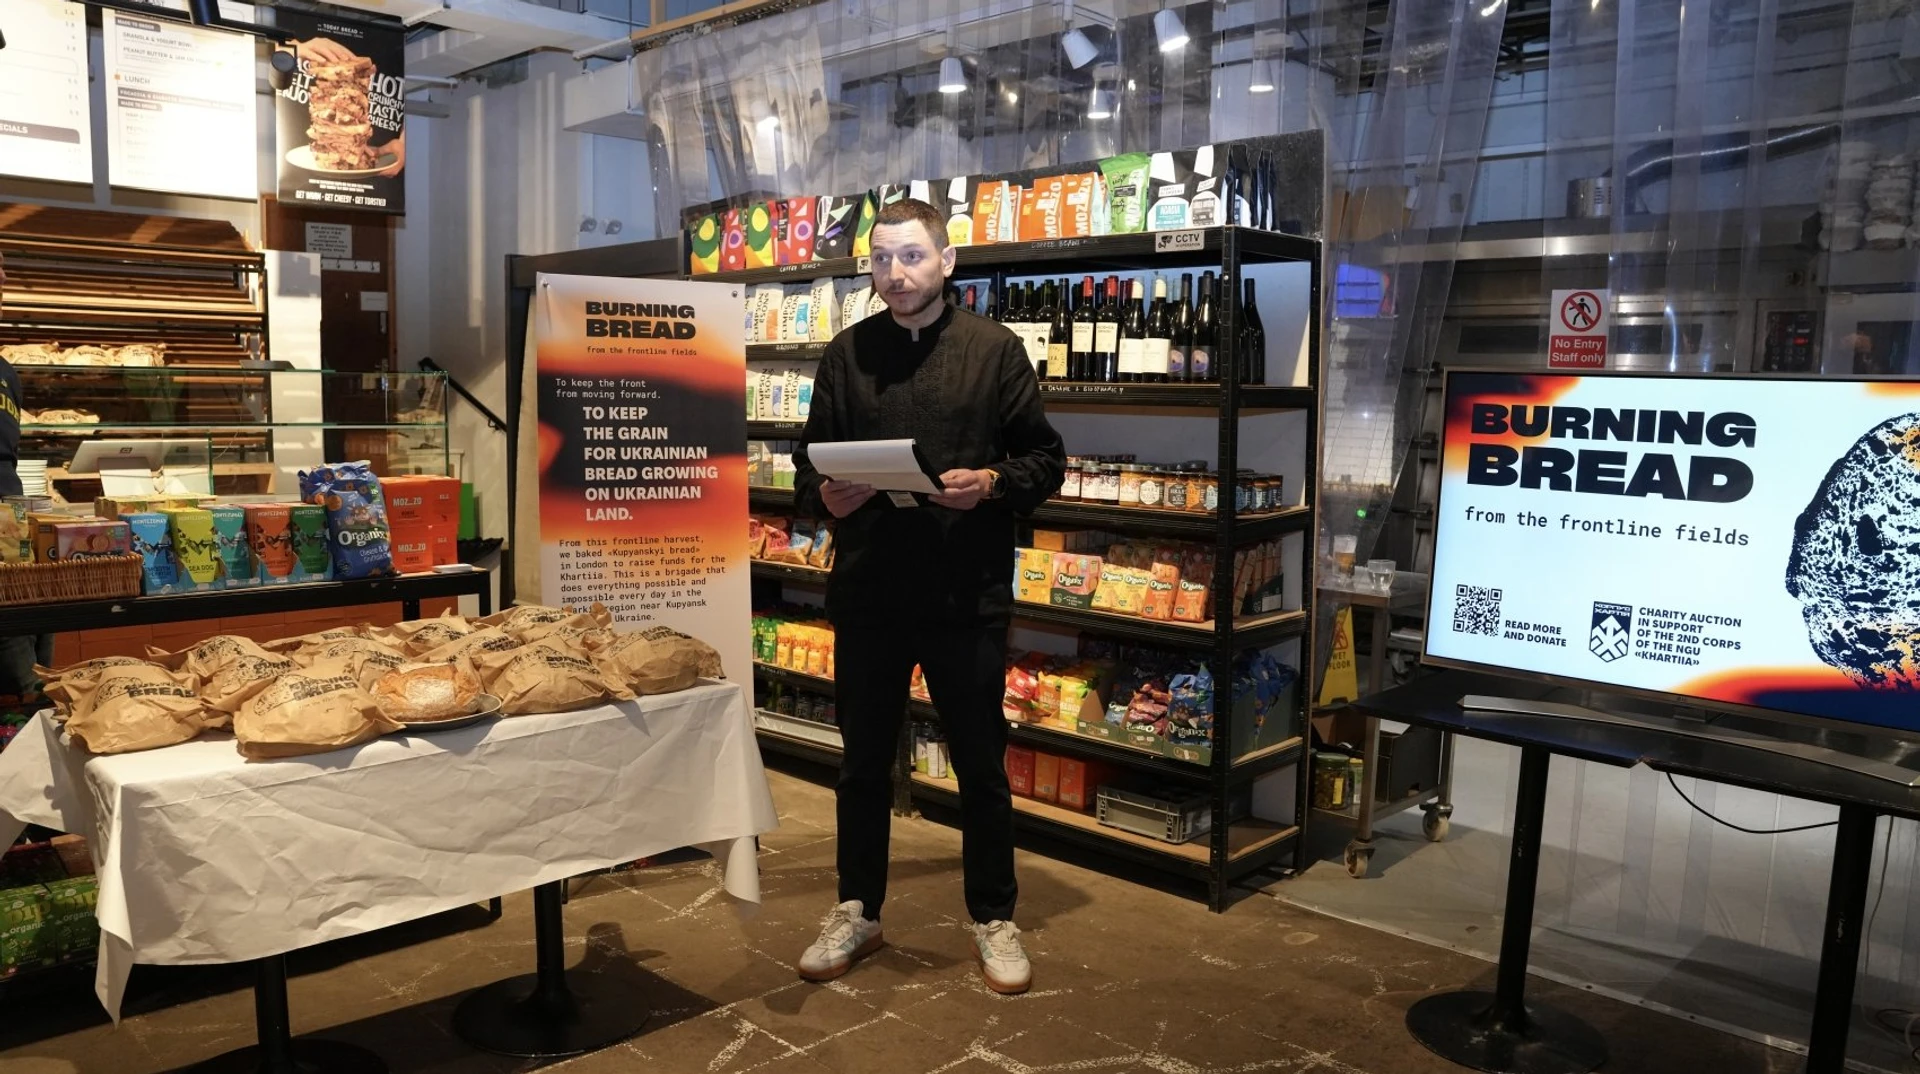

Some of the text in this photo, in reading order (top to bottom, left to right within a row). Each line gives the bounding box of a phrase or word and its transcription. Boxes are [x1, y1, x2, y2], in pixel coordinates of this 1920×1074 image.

[124, 74, 151, 85] LUNCH
[368, 72, 406, 101] HOT
[367, 91, 405, 110] CRUNCHY
[368, 101, 404, 122] TASTY
[1175, 233, 1200, 244] CCTV
[585, 301, 696, 319] BURNING
[586, 318, 696, 340] BREAD
[587, 346, 697, 356] from the frontline fields
[1555, 338, 1603, 351] No Entry
[1551, 352, 1604, 365] Staff only
[555, 378, 646, 390] To keep the front
[555, 388, 662, 400] from moving forward.
[783, 368, 794, 418] CLIMPSON
[583, 406, 649, 420] TO KEEP
[583, 426, 668, 440] THE GRAIN
[1471, 403, 1757, 449] BURNING
[584, 446, 708, 460] FOR UKRAINIAN
[584, 466, 719, 481] BREAD GROWING
[1467, 443, 1755, 503] BREAD
[585, 485, 702, 501] ON UKRAINIAN
[586, 507, 634, 521] LAND.
[1465, 506, 1750, 547] from the frontline fields
[338, 527, 387, 547] Organix
[559, 535, 705, 547] From this frontline harvest,
[559, 546, 701, 559] we baked «Kupyanskyi bread»
[188, 564, 215, 572] SEA DOG
[560, 555, 726, 570] in London to raise funds for the
[560, 571, 607, 581] Khartiia.
[613, 570, 635, 579] This
[639, 569, 650, 577] is
[665, 567, 701, 577] brigade
[706, 565, 726, 575] that
[1058, 573, 1083, 586] Organix
[561, 578, 706, 593] does everything possible and
[561, 588, 702, 605] impossible every day in the
[608, 605, 636, 614] region
[640, 602, 661, 610] near
[666, 599, 707, 609] Kupyansk
[614, 614, 656, 623] Ukraine.
[1639, 607, 1742, 627] CHARITY AUCTION
[1505, 620, 1562, 635] READ MORE
[1637, 618, 1704, 634] IN SUPPORT
[1503, 631, 1567, 647] AND DONATE
[1637, 629, 1742, 650] OF THE 2ND CORPS
[1636, 639, 1701, 656] OF THE NGU
[1332, 651, 1347, 660] WET
[1635, 650, 1700, 667] «KHARTIIA»
[1328, 659, 1351, 670] FLOOR
[1168, 721, 1206, 738] Organix
[63, 911, 96, 921] organi
[9, 921, 46, 934] organic
